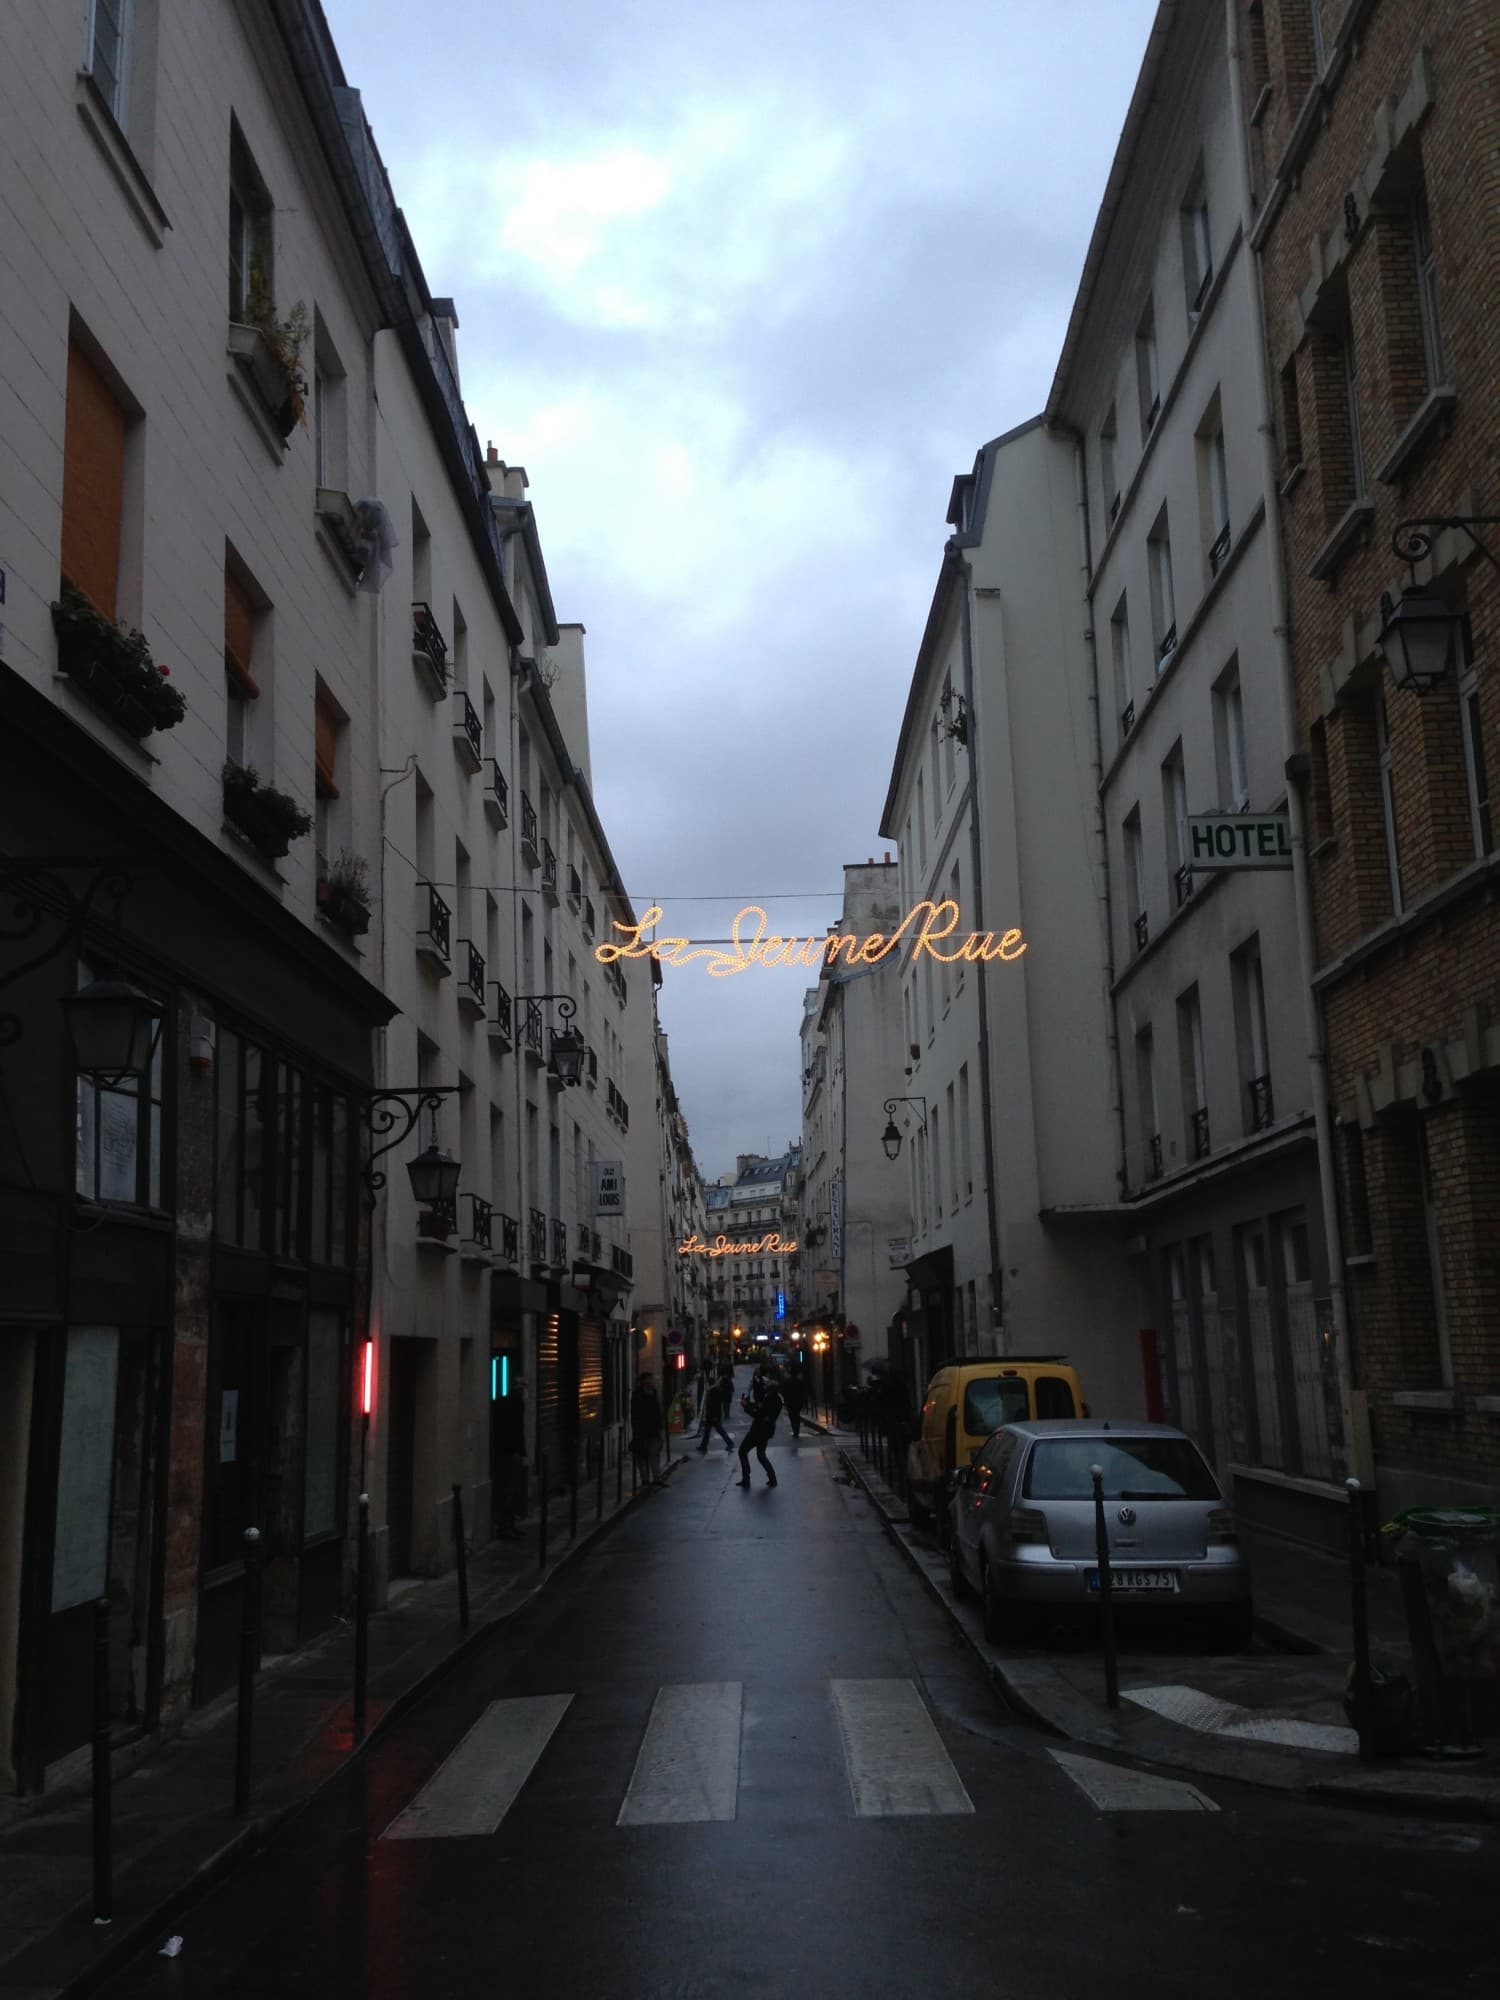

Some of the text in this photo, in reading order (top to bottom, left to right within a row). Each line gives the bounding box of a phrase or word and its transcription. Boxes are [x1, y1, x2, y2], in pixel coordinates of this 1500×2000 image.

[1192, 823, 1292, 857] HOTEL
[594, 899, 1027, 977] La Jeune Rue
[678, 1233, 798, 1256] La Jeune Rue
